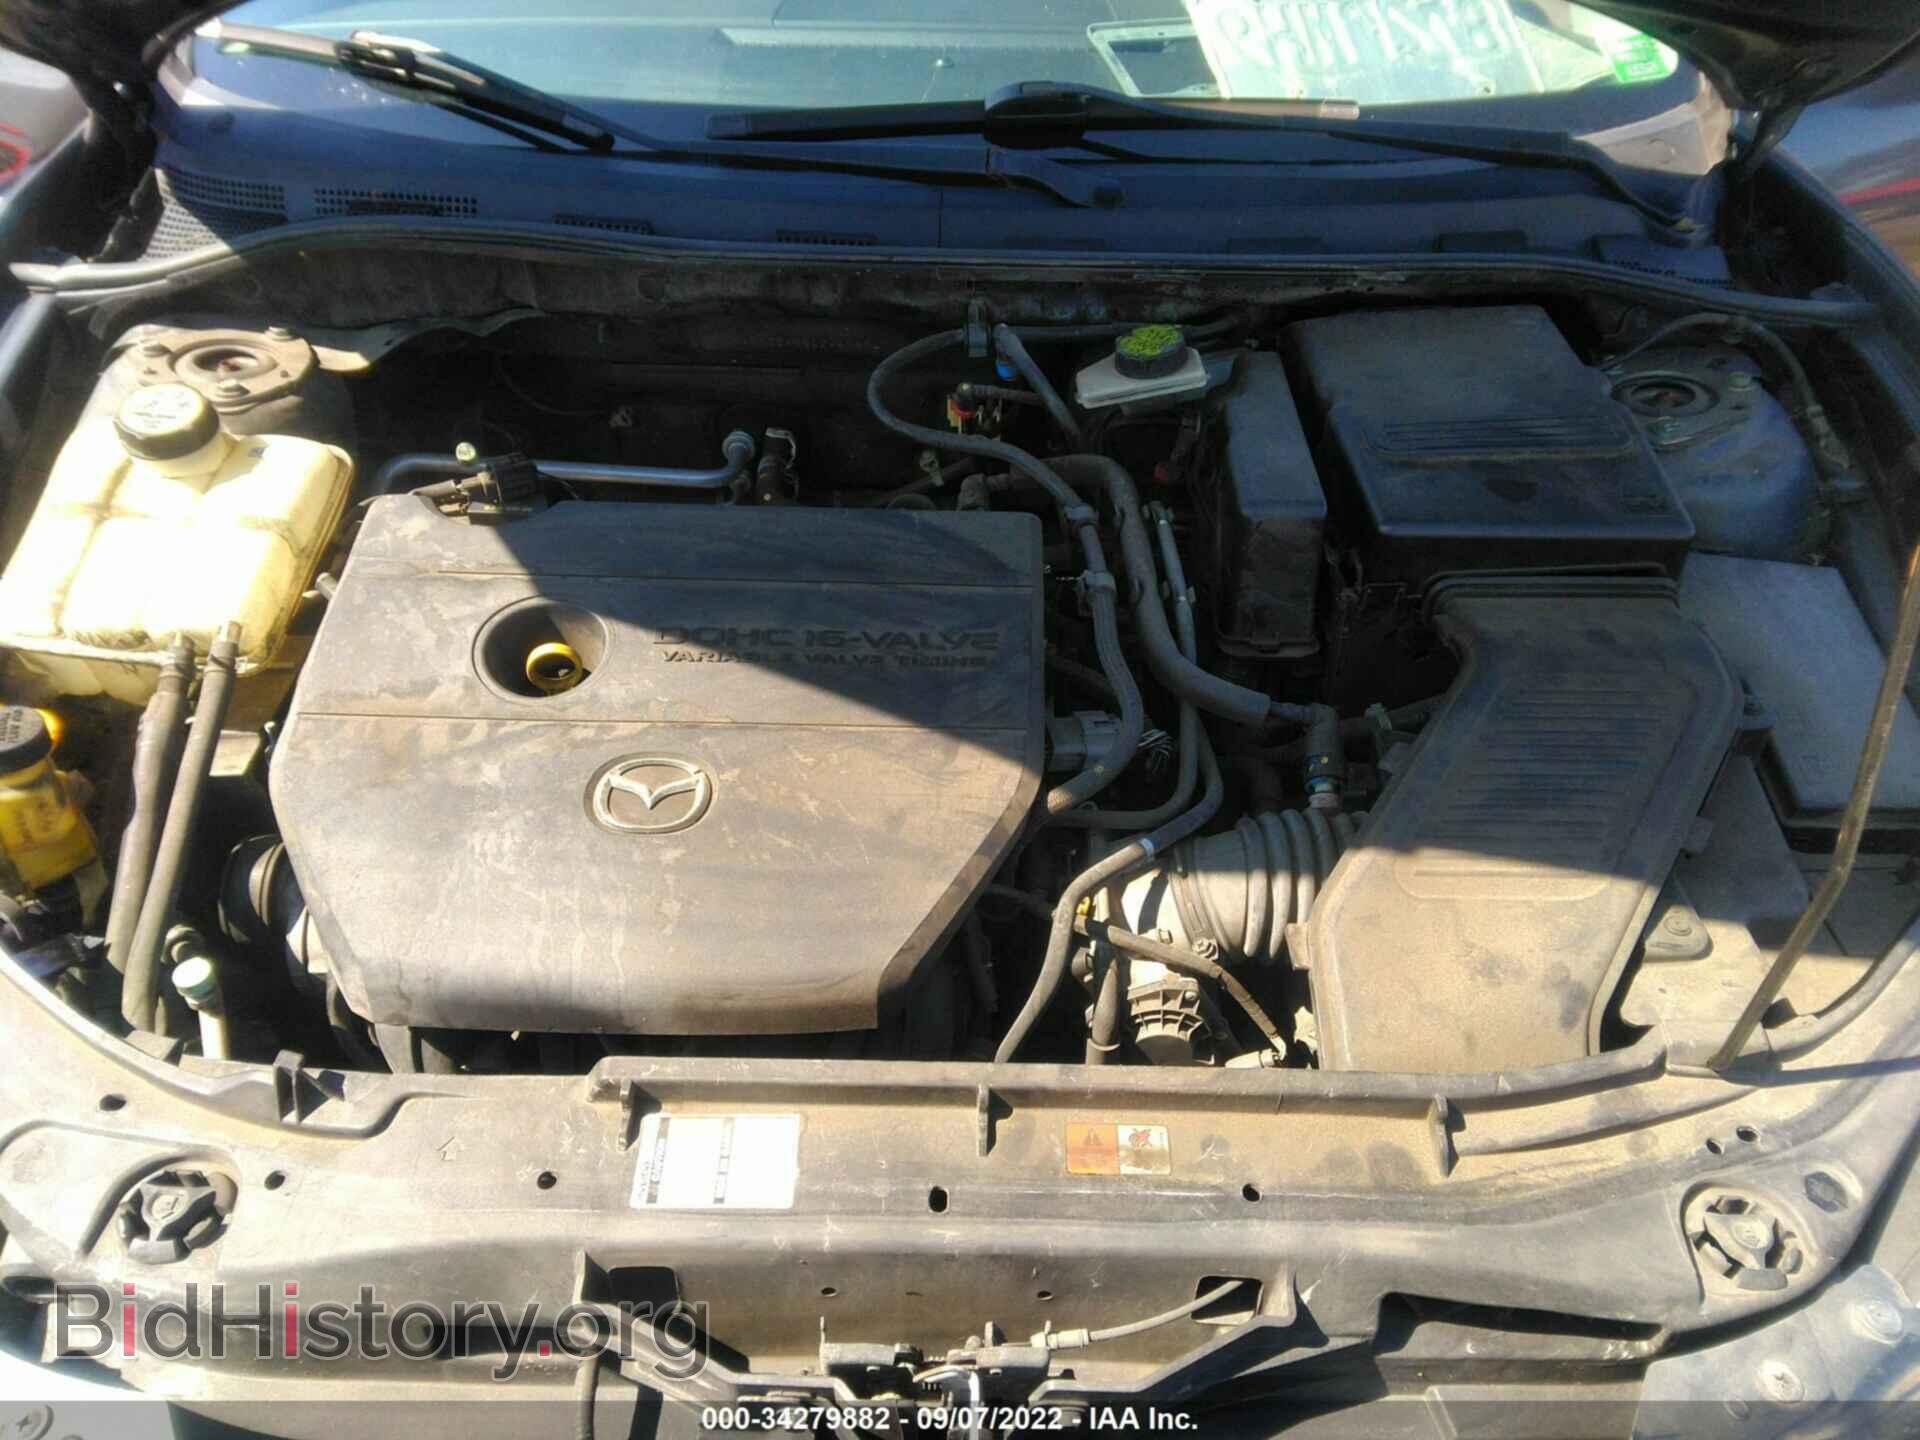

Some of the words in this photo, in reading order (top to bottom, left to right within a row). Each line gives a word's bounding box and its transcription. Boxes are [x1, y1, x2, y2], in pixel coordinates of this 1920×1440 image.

[654, 627, 792, 646] DOHC
[804, 629, 1000, 651] 16-VALVE
[804, 653, 884, 666] VALVE
